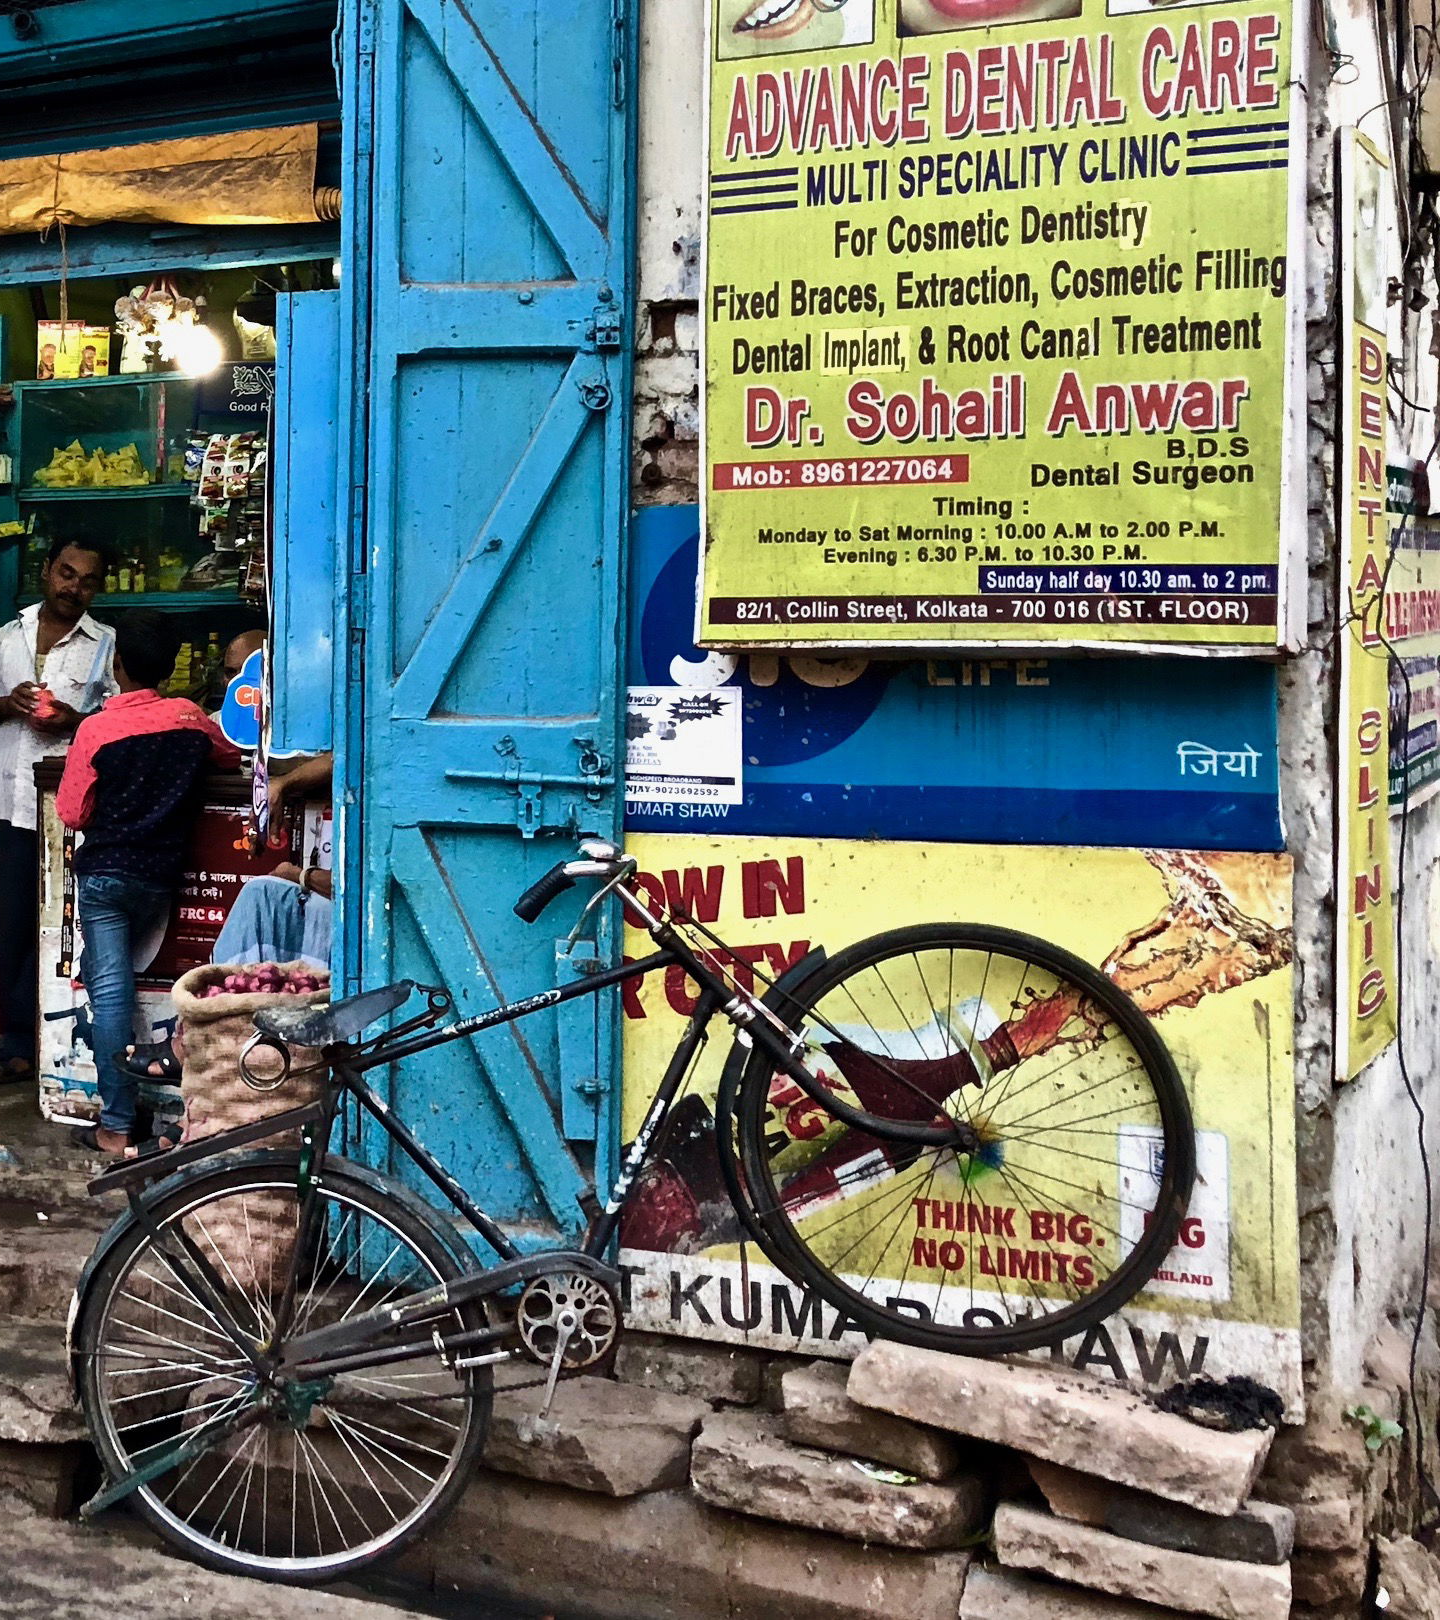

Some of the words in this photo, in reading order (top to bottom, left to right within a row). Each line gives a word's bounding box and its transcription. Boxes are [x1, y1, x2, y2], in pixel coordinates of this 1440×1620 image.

[725, 55, 930, 159] ADVANCE
[945, 34, 1125, 138] DENTAL
[1142, 15, 1279, 118] CARE
[806, 159, 888, 207] MULTI
[898, 142, 1068, 199] SPECIALITY
[1078, 131, 1181, 184] CLINIC
[835, 220, 877, 258] For
[887, 208, 1010, 255] Cosmetic
[1021, 200, 1148, 246] Dentistry
[713, 281, 780, 322] Fixed
[791, 279, 885, 317] Braces,
[897, 265, 1039, 309] Extraction,
[1051, 253, 1183, 300] Cosmetic
[1196, 248, 1287, 298] Filling
[733, 333, 811, 375] Dental
[824, 330, 906, 375] Implant,
[918, 325, 936, 365] &
[947, 325, 1010, 363] Root
[1020, 317, 1100, 360] Canal
[1112, 312, 1262, 355] Treatment
[229, 402, 257, 412] Good
[746, 386, 823, 447] Dr.
[847, 375, 1026, 445] Sohail
[1047, 371, 1250, 437] Anwar
[732, 466, 791, 486] Mob:
[801, 459, 953, 485] 8961227064
[1031, 462, 1119, 487] Dental
[1132, 461, 1254, 490] Surgeon
[932, 497, 1012, 519] Timing
[1355, 336, 1383, 649] DENTAL
[758, 528, 827, 546] Monday
[834, 529, 851, 542] to
[859, 526, 890, 541] Sat
[897, 524, 973, 543] Morning
[994, 523, 1046, 539] 10.00
[1053, 523, 1092, 539] A.M
[1099, 523, 1119, 538] to
[1126, 521, 1170, 538] 2.00
[1178, 520, 1226, 538] P.M.
[823, 548, 897, 566] Evening
[917, 546, 957, 562] 6.30
[964, 546, 1007, 562] P.M.
[1015, 546, 1034, 561] to
[1042, 545, 1095, 561] 10.30
[1102, 544, 1148, 561] P.M.
[986, 570, 1044, 593] Sunday
[1049, 570, 1079, 589] half
[1083, 570, 1112, 592] day
[1119, 570, 1161, 589] 10.30
[1167, 574, 1196, 589] am.
[1202, 572, 1218, 588] to
[1224, 570, 1235, 588] 2
[1241, 574, 1271, 593] pm.
[736, 602, 779, 620] 82/1,
[786, 602, 839, 618] Collin
[847, 601, 908, 620] Street,
[916, 601, 988, 618] Kolkata
[1011, 600, 1053, 618] 700
[1054, 600, 1090, 618] 016
[1097, 600, 1152, 623] (1ST.
[1160, 601, 1250, 623] FLOOR)
[1177, 741, 1262, 778] जियो
[625, 784, 720, 796] NJAY-9073692592
[625, 801, 674, 817] UMAR
[678, 803, 730, 818] SHAW
[199, 871, 208, 882] 6
[1355, 709, 1387, 1019] CLINIC
[624, 864, 725, 929] OW
[741, 855, 806, 919] IN
[179, 907, 205, 921] FRC
[207, 909, 224, 922] 64
[911, 1197, 1017, 1238] THINK
[1030, 1209, 1106, 1248] BIG.
[913, 1237, 966, 1271] NO
